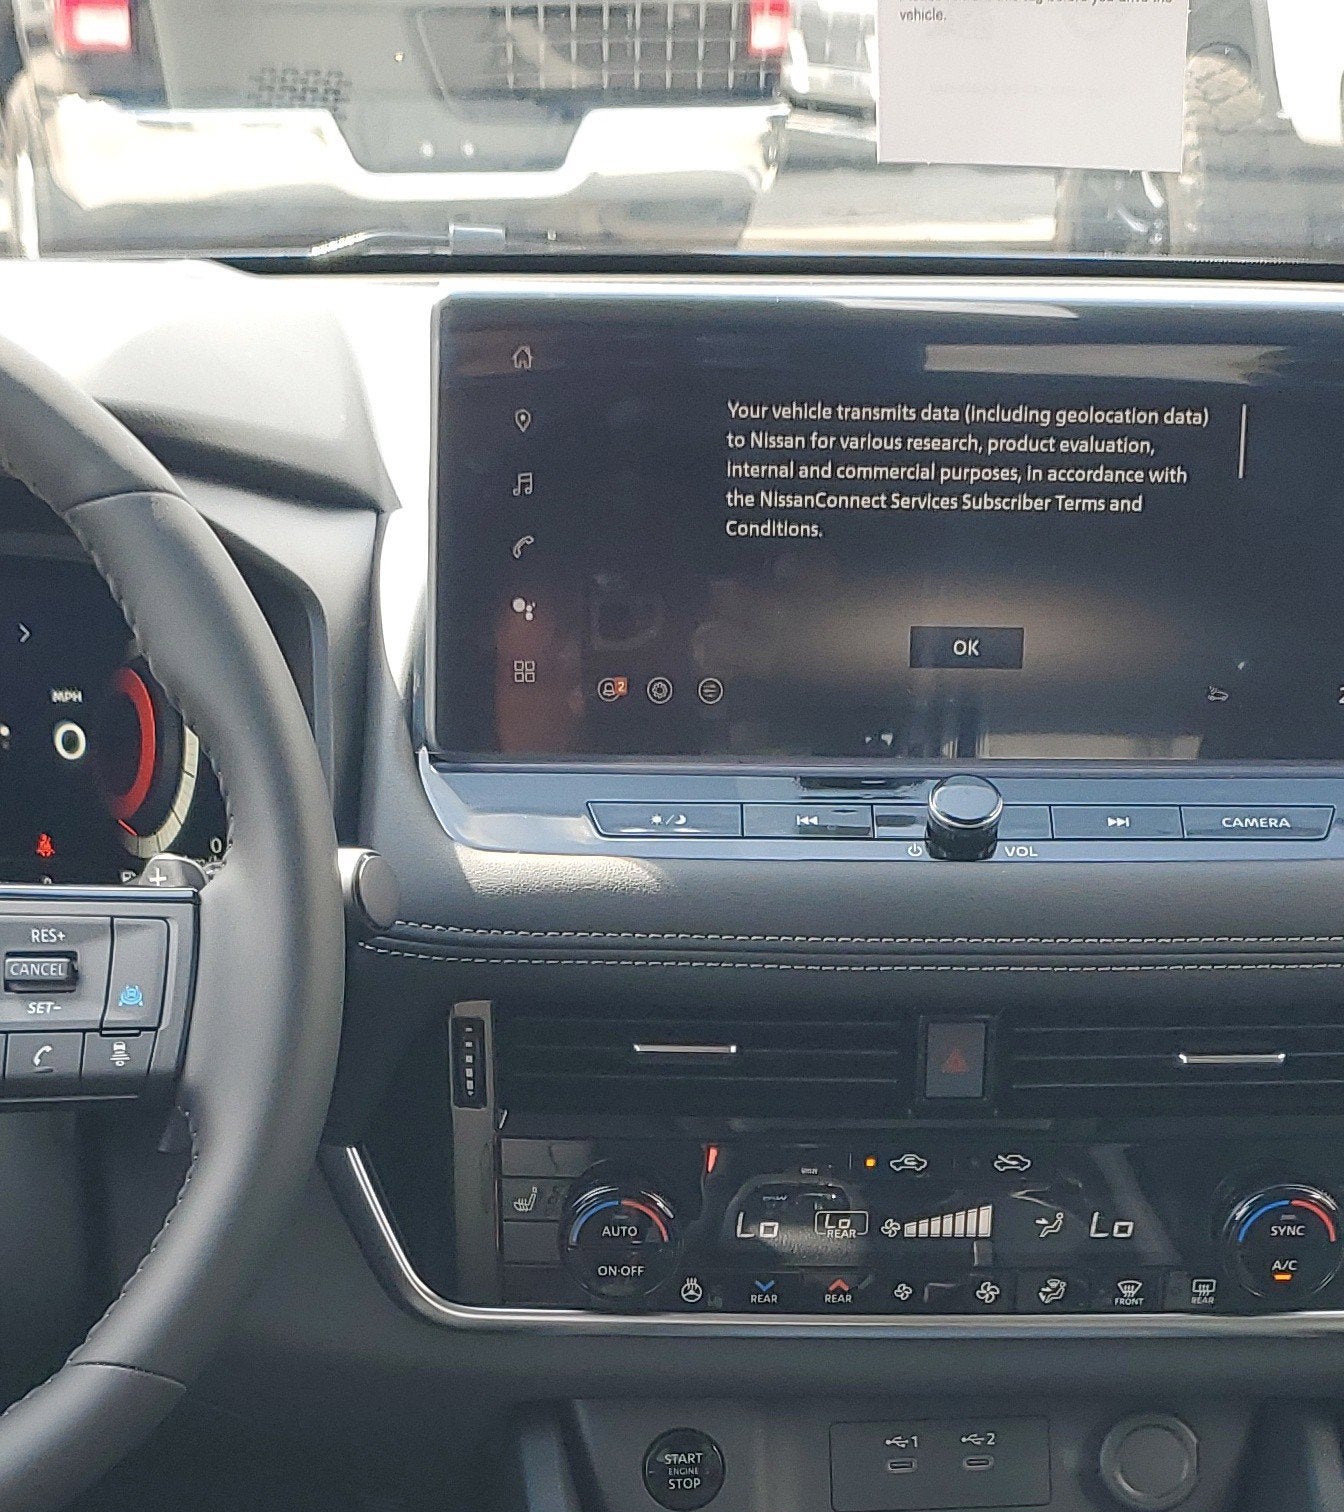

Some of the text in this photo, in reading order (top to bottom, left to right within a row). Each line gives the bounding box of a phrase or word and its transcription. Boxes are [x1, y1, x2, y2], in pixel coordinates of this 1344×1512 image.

[728, 401, 1208, 427] Your vehicle transmits data (including geolocation data)
[727, 432, 1154, 456] to Nissan for various research, product evaluation,
[728, 460, 1187, 484] internal and commercial purposes, in accordance with
[726, 490, 1142, 512] the NissanConnect Services Subscriber Terms and
[726, 519, 822, 537] Conditions.
[951, 638, 981, 658] OK
[54, 722, 86, 760] 0
[1220, 815, 1291, 831] CAMERA
[1004, 844, 1038, 859] VOL
[31, 928, 66, 943] RES+
[10, 963, 65, 976] CANCEL
[601, 1225, 638, 1237] AUTO
[827, 1229, 857, 1239] REAR
[1270, 1225, 1306, 1237] SYNC
[1272, 1260, 1297, 1272] A/C
[751, 1294, 778, 1303] REAR
[825, 1294, 852, 1303] REAR
[1113, 1297, 1144, 1306] FRONT
[1191, 1296, 1215, 1305] REAR
[911, 1436, 918, 1448] 1
[986, 1433, 996, 1445] 2
[665, 1452, 704, 1465] START
[668, 1467, 699, 1476] ENGINE
[668, 1477, 701, 1490] STOP
